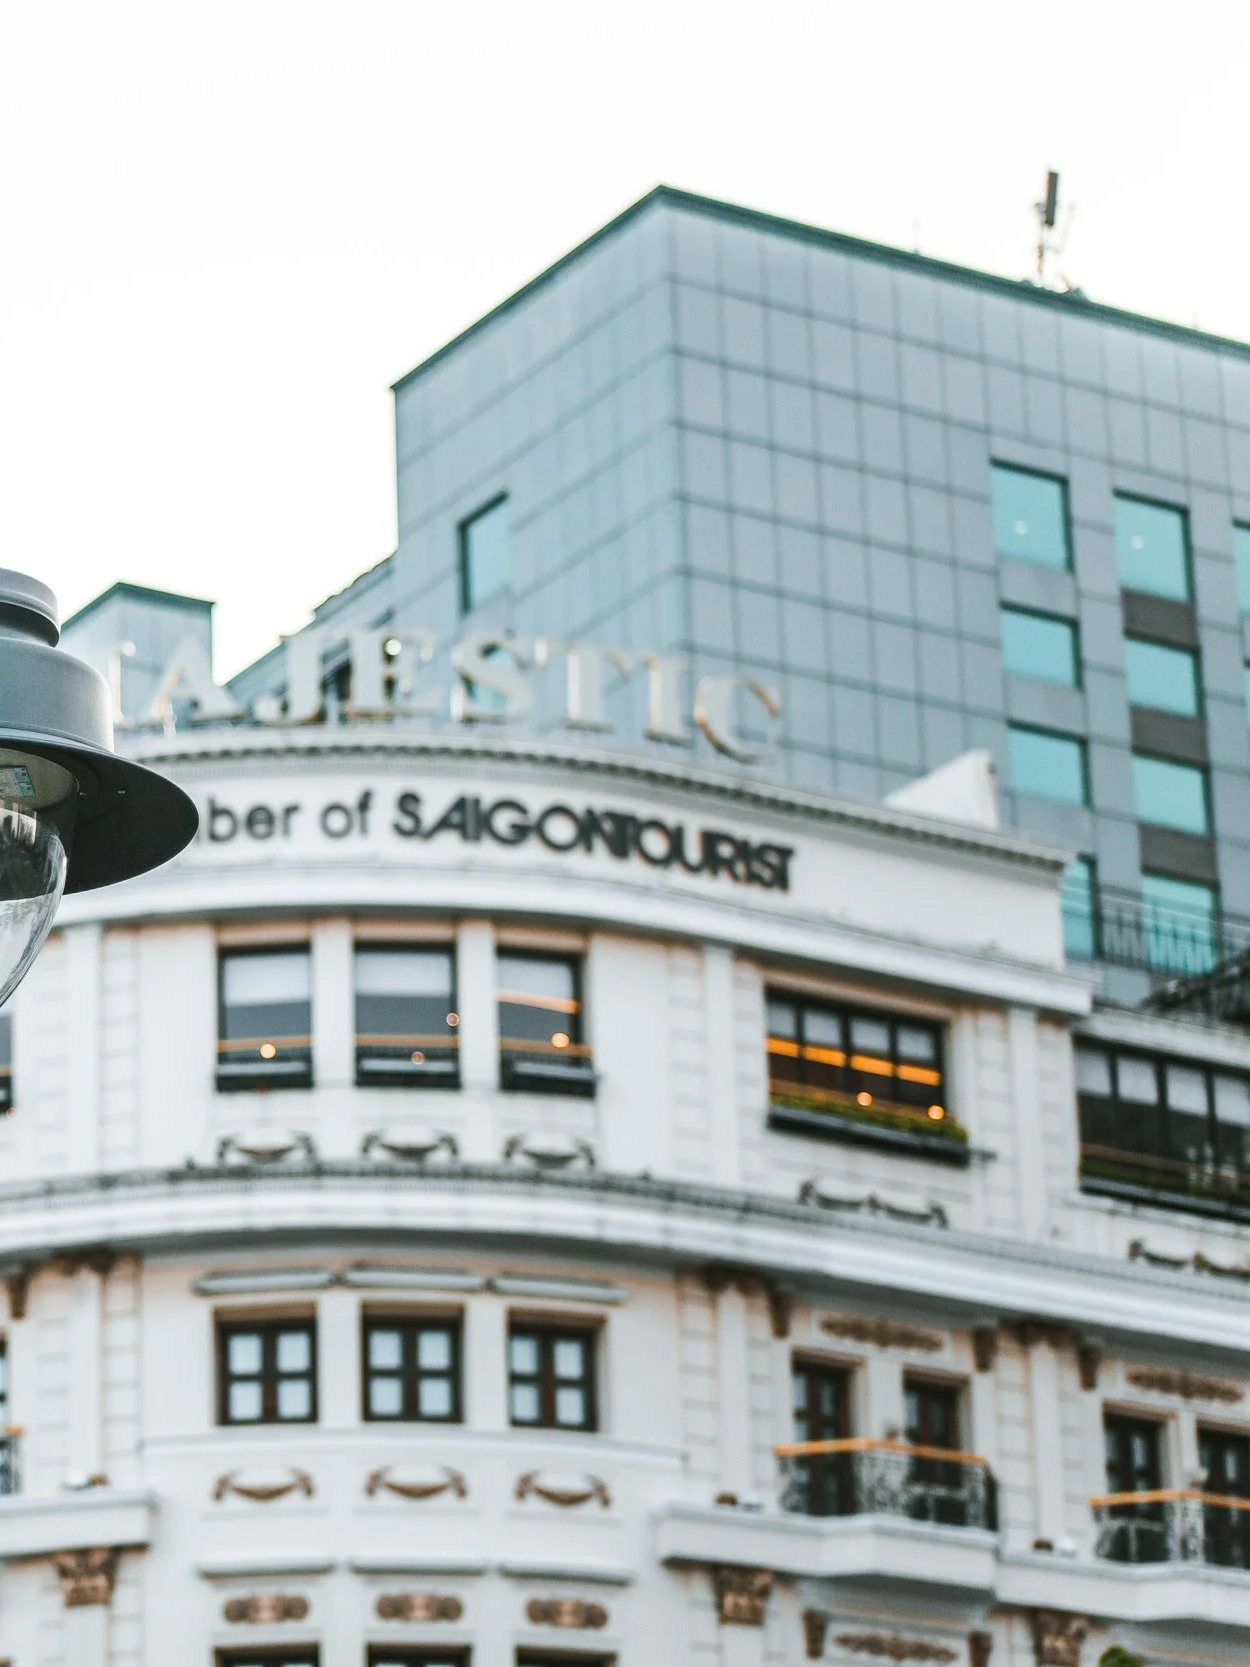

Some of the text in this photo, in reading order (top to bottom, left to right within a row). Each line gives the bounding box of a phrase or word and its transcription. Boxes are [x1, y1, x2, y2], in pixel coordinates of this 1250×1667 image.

[108, 628, 781, 766] AJESTIC
[195, 788, 795, 893] ber of SAIGONTOURIST
